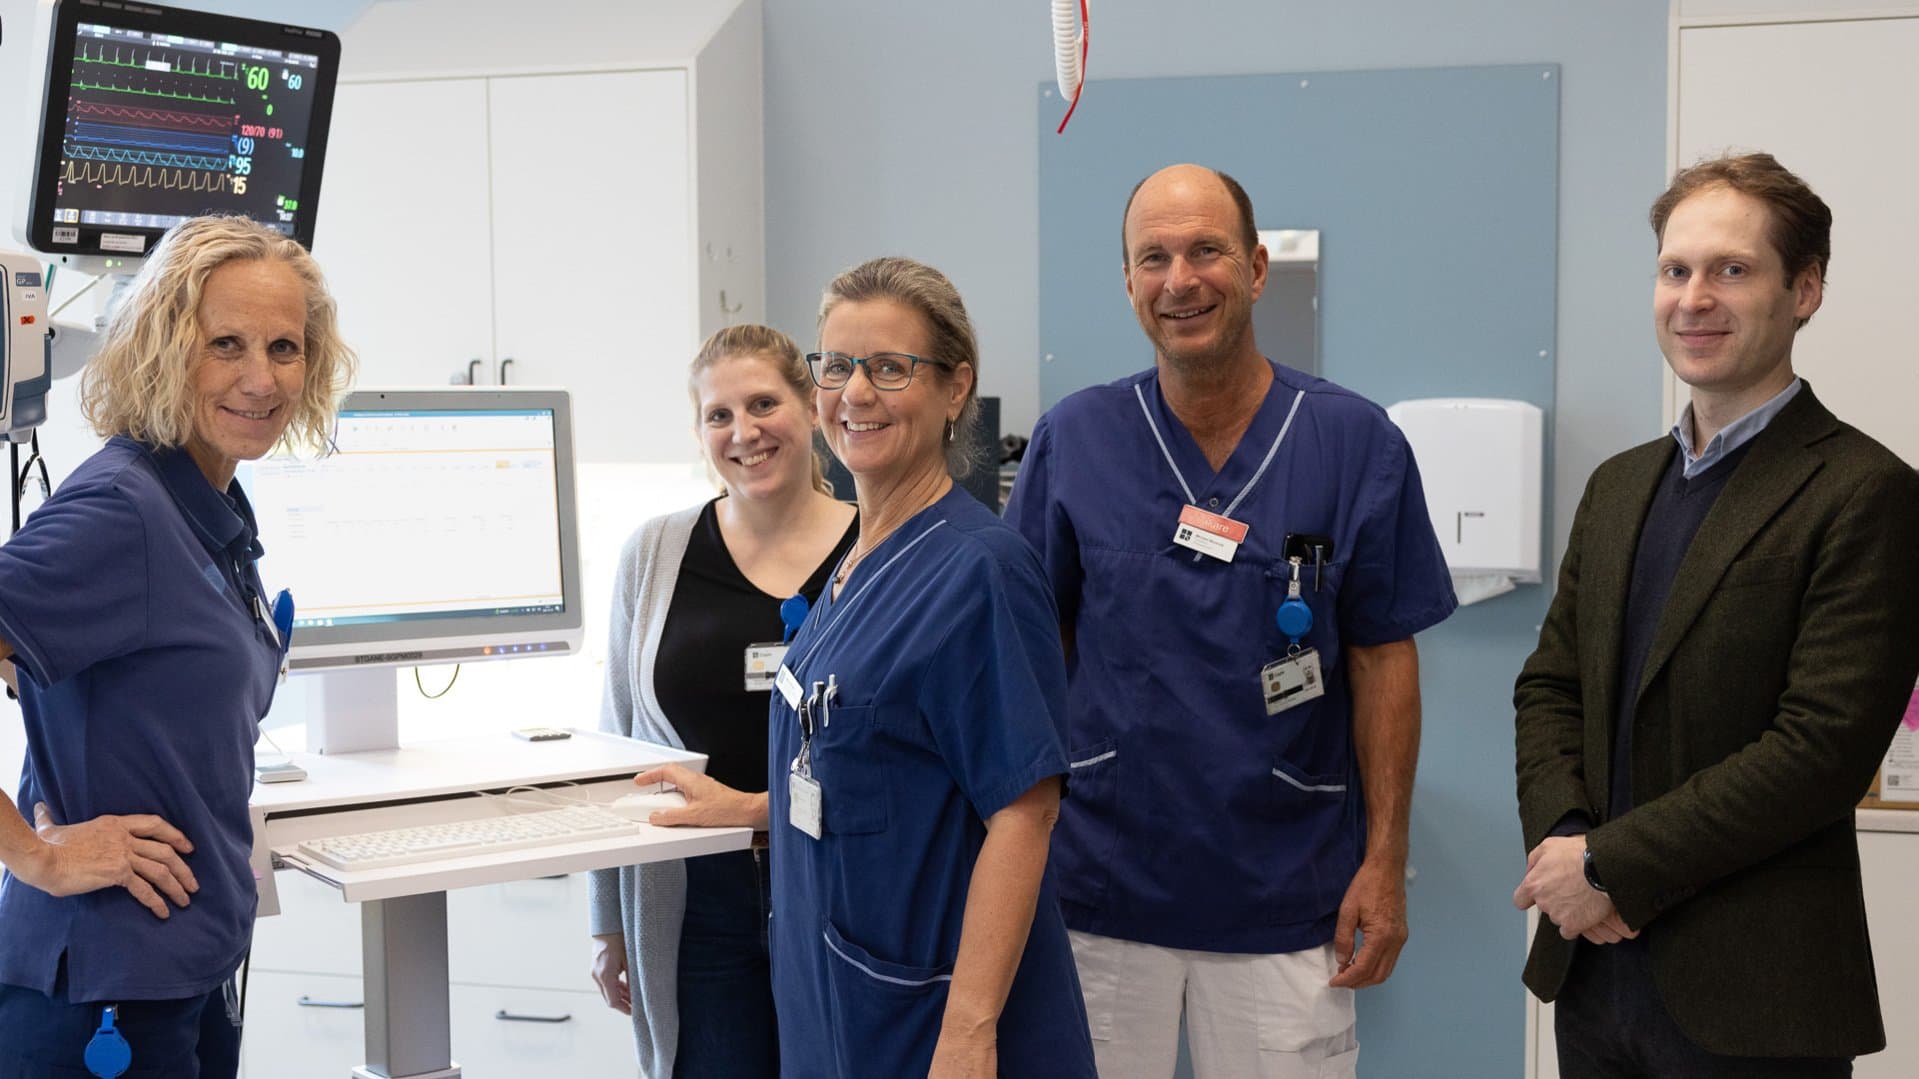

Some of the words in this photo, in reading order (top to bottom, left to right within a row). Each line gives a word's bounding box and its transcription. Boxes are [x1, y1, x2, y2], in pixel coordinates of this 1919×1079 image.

[247, 66, 269, 90] 60
[288, 74, 302, 90] 60
[266, 104, 273, 116] 0
[241, 124, 266, 138] 120/70
[268, 127, 284, 139] (91)
[237, 137, 255, 155] (9)
[235, 157, 252, 175] 95
[233, 176, 247, 195] 15
